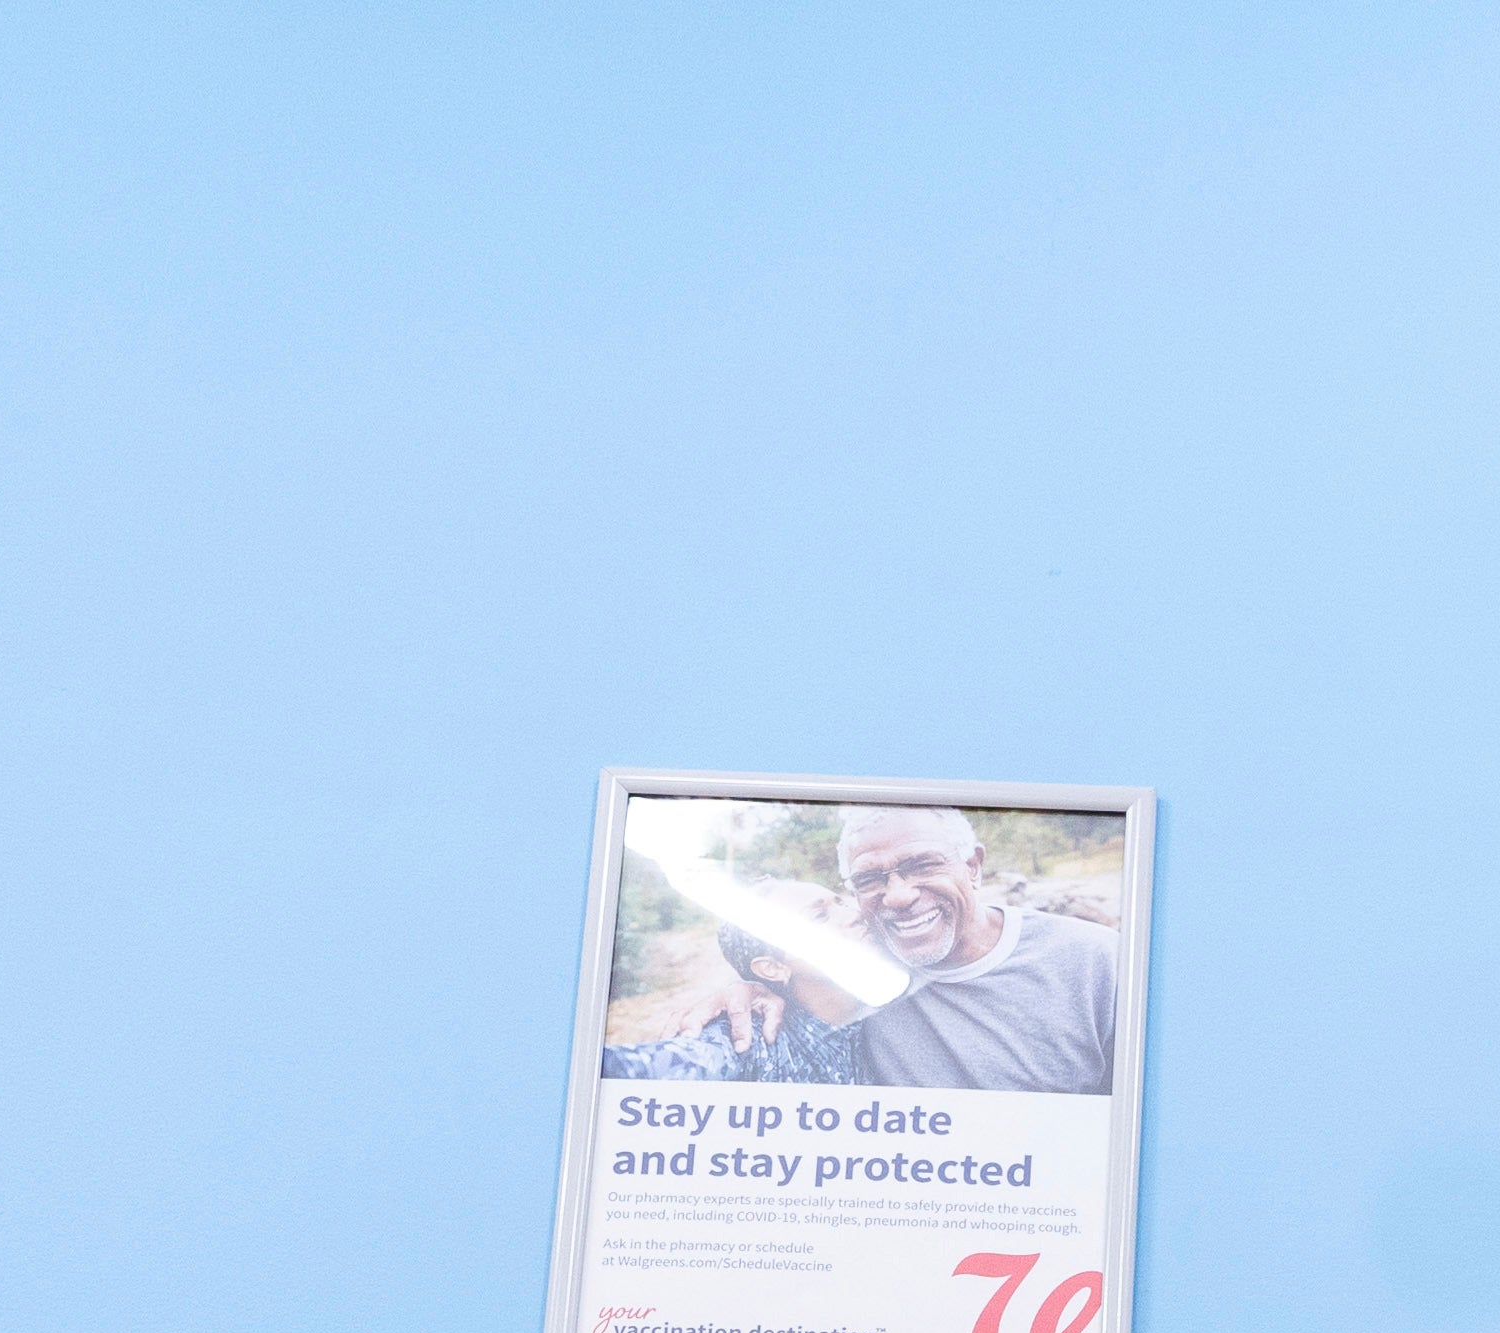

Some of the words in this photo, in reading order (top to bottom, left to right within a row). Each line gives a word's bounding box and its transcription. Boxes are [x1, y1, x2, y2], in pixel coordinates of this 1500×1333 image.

[617, 1096, 715, 1136] Stay
[728, 1105, 782, 1137] up
[796, 1101, 840, 1131] to
[854, 1101, 952, 1135] date
[612, 1143, 696, 1176] and
[709, 1147, 802, 1187] stay
[815, 1153, 1032, 1188] protected
[608, 1191, 633, 1202] Our
[635, 1192, 701, 1205] pharmacy
[703, 1195, 752, 1207] experts
[754, 1197, 776, 1206] are
[778, 1195, 835, 1208] specially
[838, 1197, 885, 1209] trained
[888, 1200, 901, 1210] to
[904, 1200, 942, 1213] safely
[945, 1202, 995, 1214] provide
[998, 1203, 1019, 1214] the
[1022, 1205, 1077, 1217] vaccines
[606, 1210, 630, 1222] you
[634, 1209, 670, 1221] need,
[673, 1210, 734, 1224] including
[736, 1211, 801, 1224] COVID-19,
[804, 1212, 861, 1228] shingles,
[864, 1217, 939, 1229] pneumonia
[942, 1218, 967, 1230] and
[970, 1220, 1036, 1235] whooping
[1038, 1221, 1082, 1236] cough.
[602, 1239, 628, 1249] Ask
[630, 1239, 642, 1249] in
[645, 1239, 667, 1250] the
[669, 1241, 736, 1255] pharmacy
[738, 1244, 753, 1252] or
[755, 1242, 814, 1254] schedule
[602, 1256, 616, 1266] at
[617, 1256, 833, 1272] Walgreens.com/ScheduleVaccine
